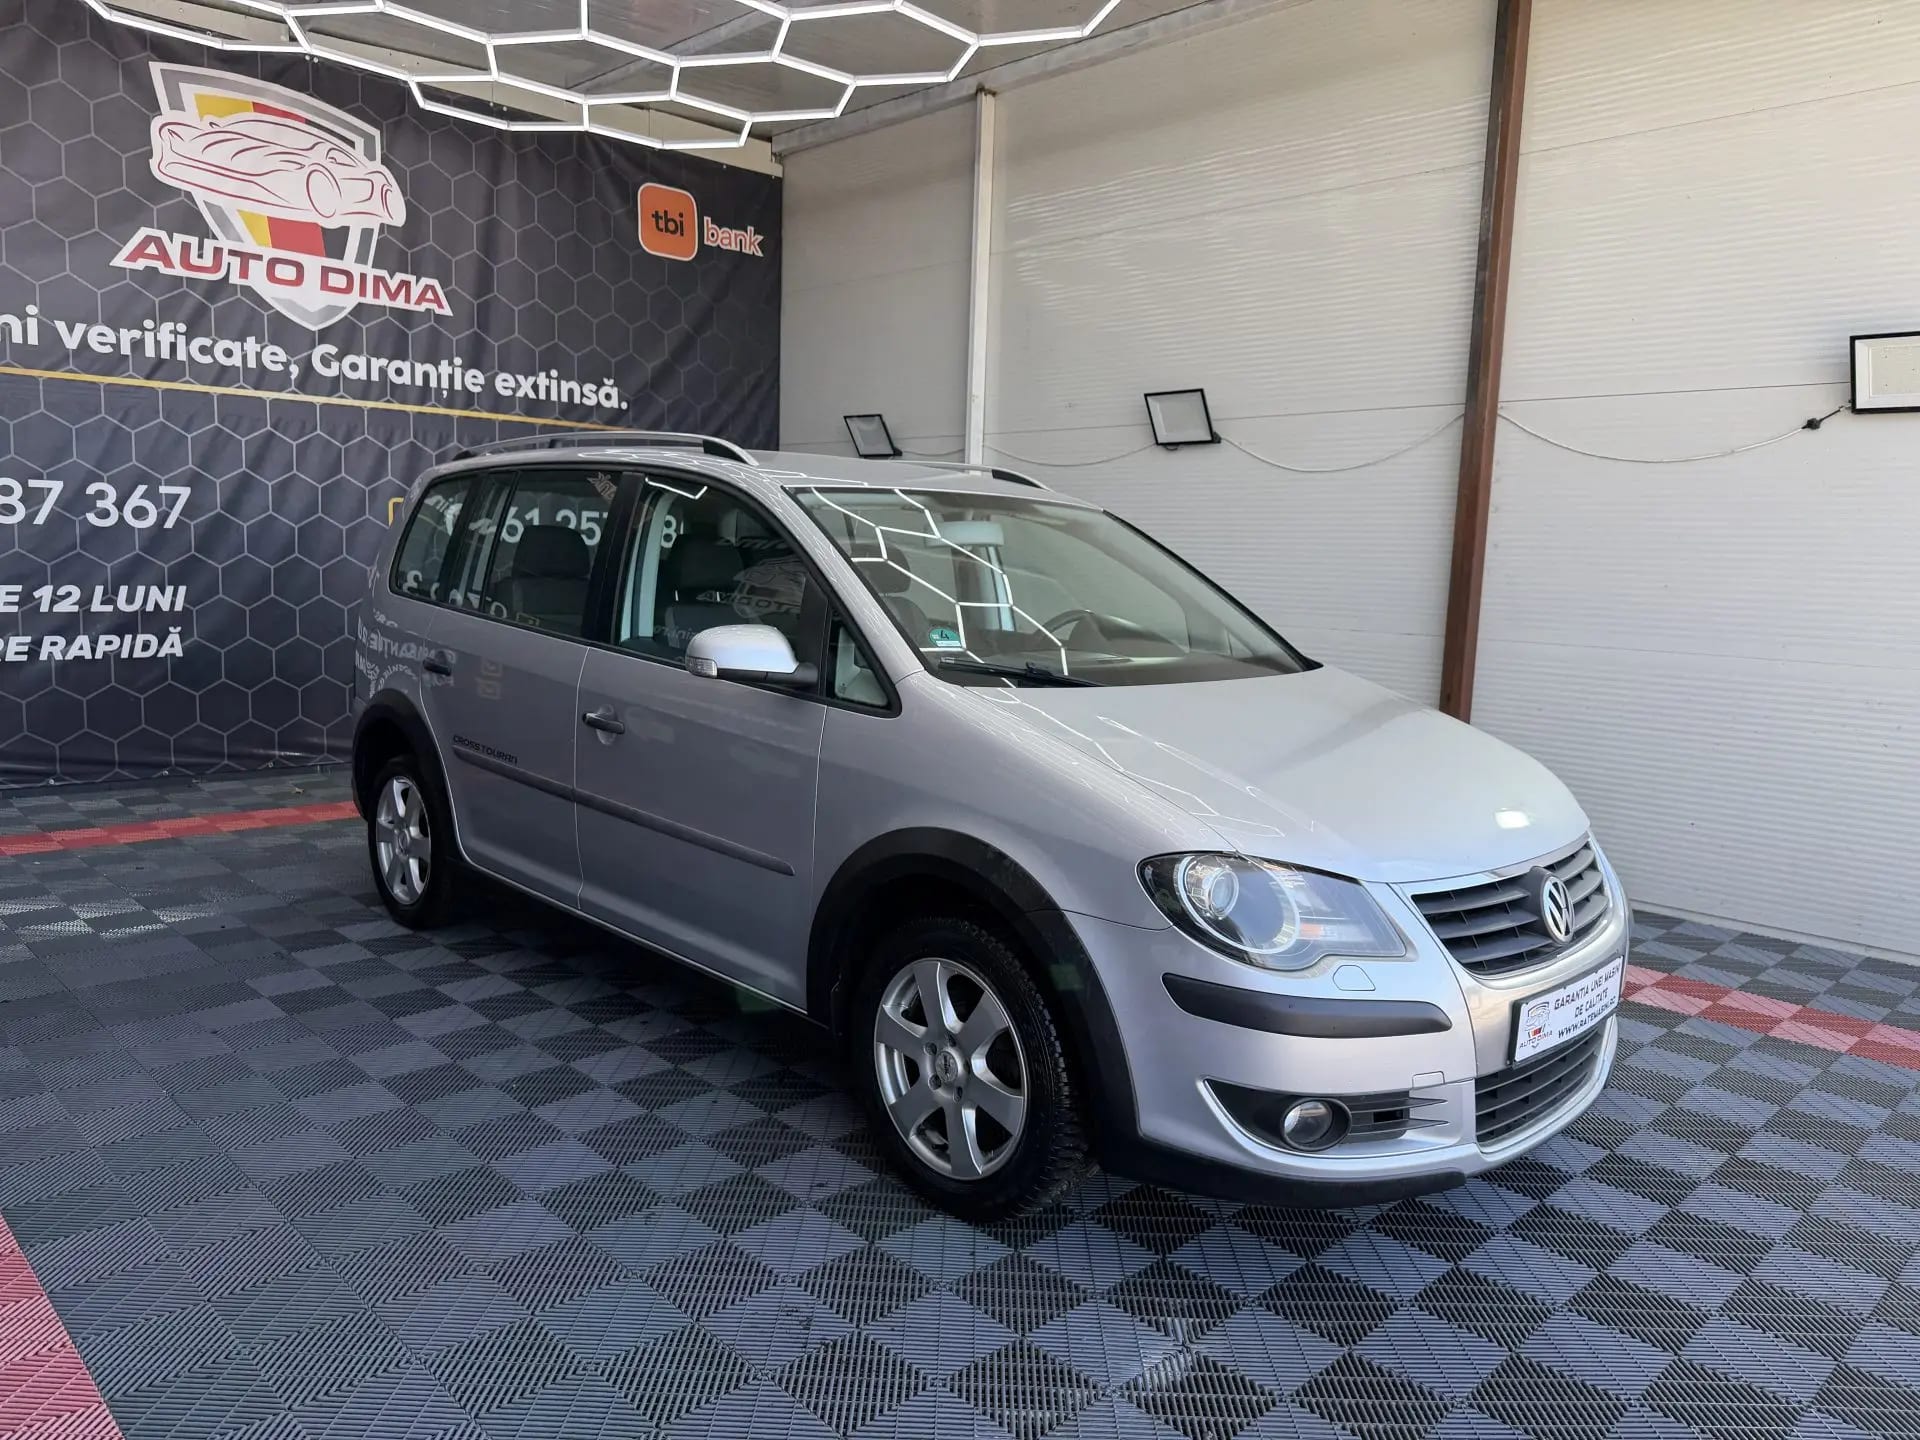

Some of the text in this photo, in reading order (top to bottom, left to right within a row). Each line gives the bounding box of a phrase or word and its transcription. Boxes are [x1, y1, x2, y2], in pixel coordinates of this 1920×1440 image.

[651, 210, 764, 257] tbi bank
[122, 233, 445, 309] AUTO DIMA
[54, 319, 300, 380] verificate,
[311, 343, 485, 399] Garanție
[495, 369, 628, 410] extinsă.
[0, 477, 192, 529] 87 367
[32, 584, 82, 613] 12
[90, 584, 187, 613] LUNI
[0, 626, 184, 662] E RAPIDĂ
